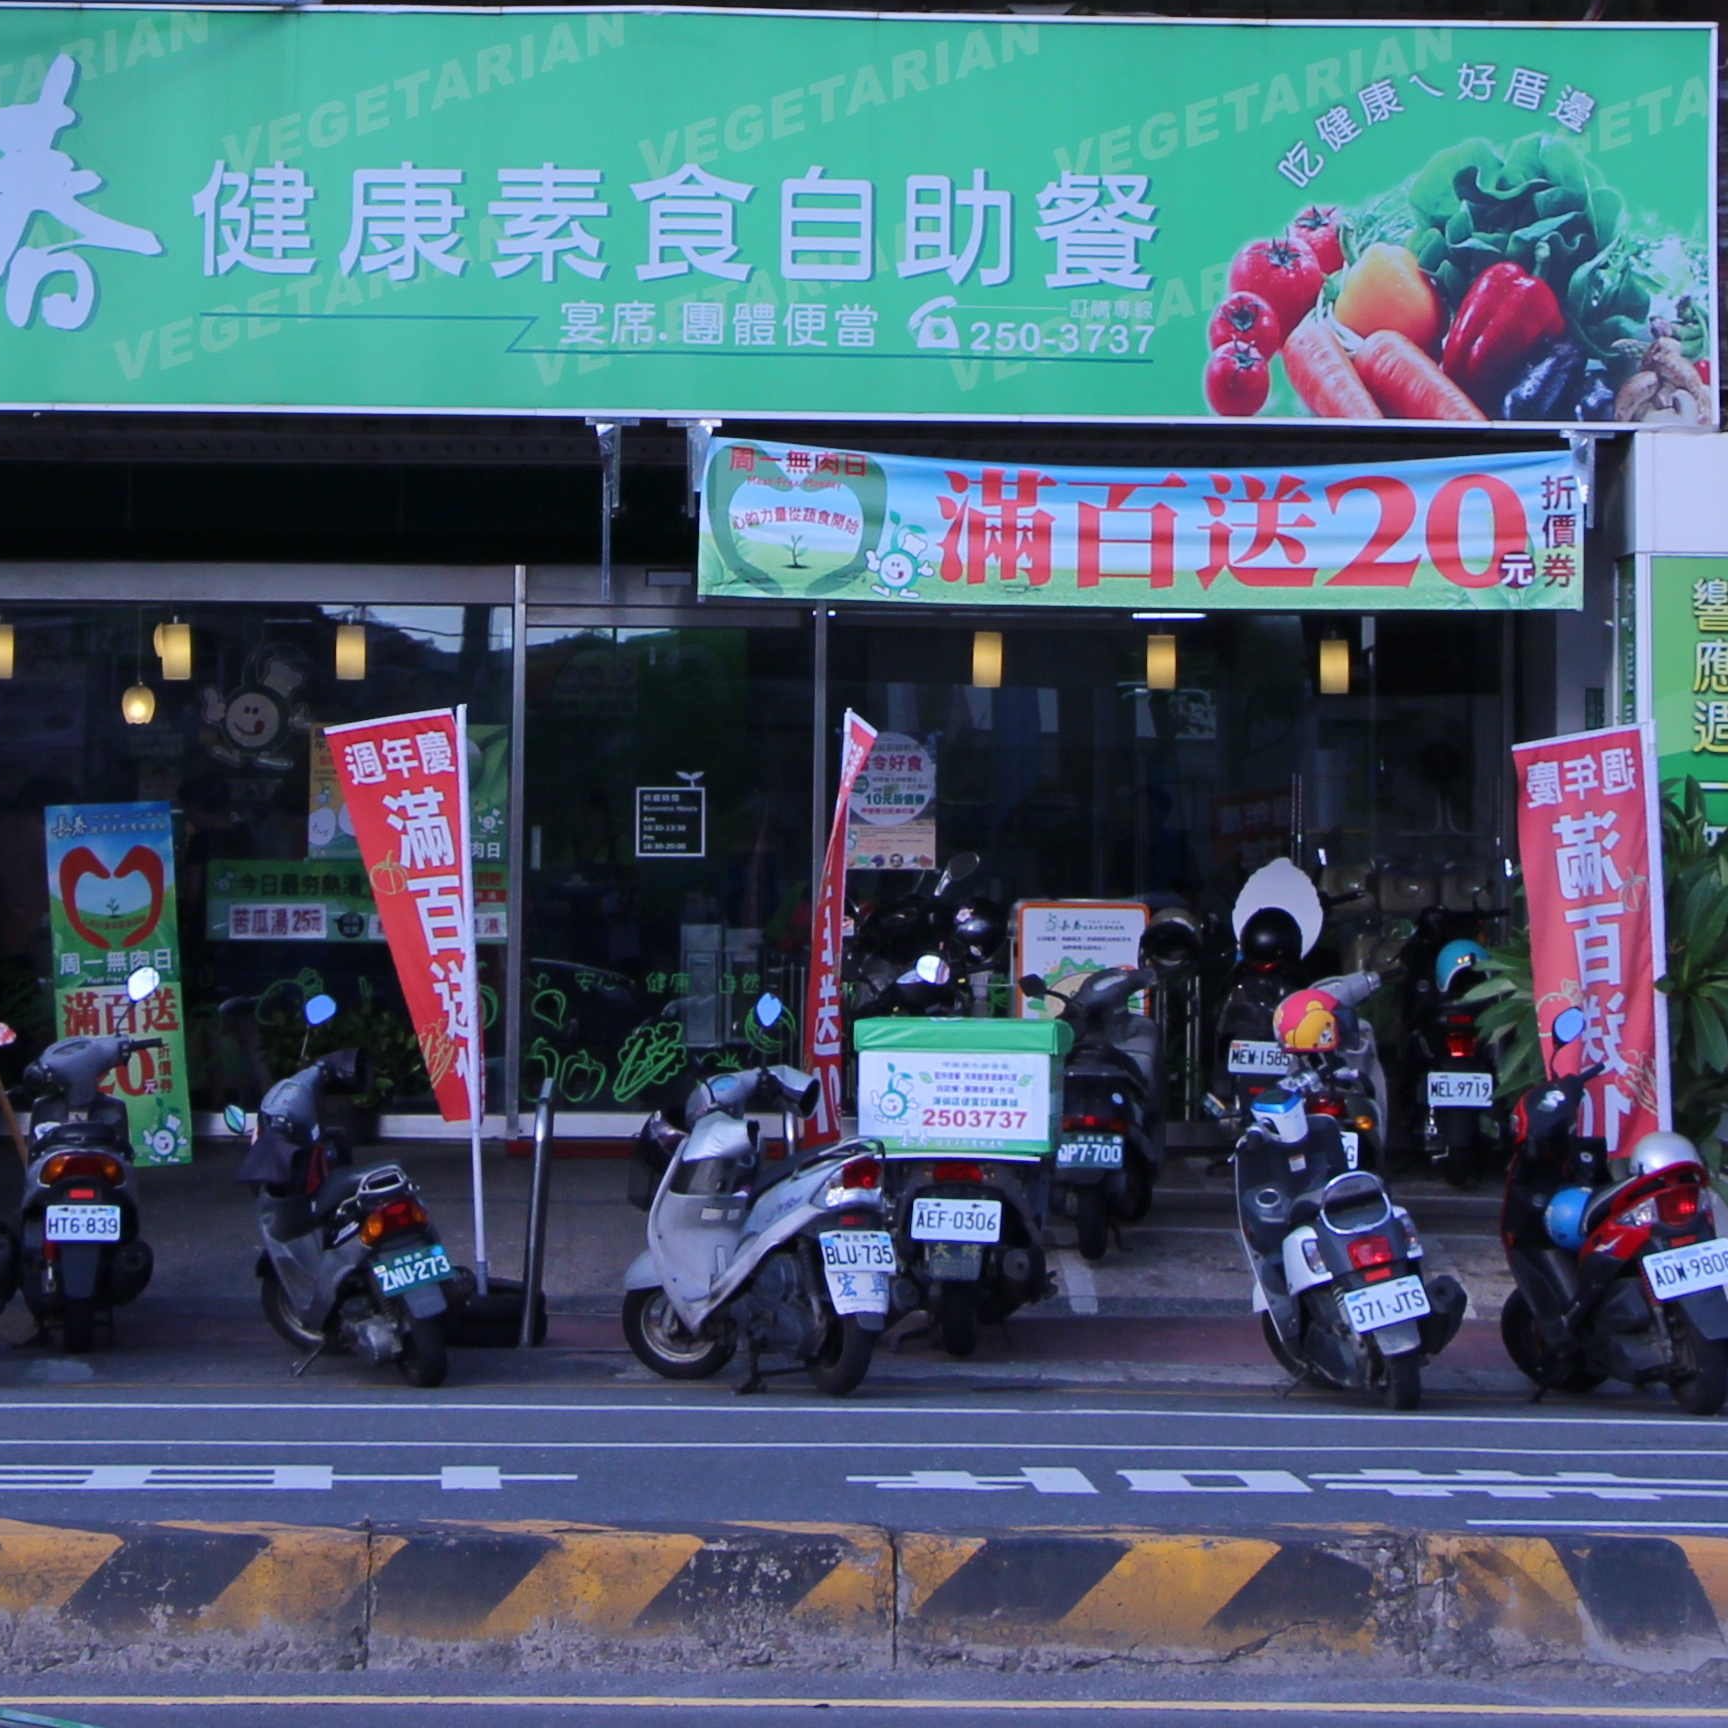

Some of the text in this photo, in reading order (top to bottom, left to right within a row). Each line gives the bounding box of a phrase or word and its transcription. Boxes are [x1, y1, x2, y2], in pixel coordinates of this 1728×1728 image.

[1052, 27, 1455, 180] VEGETARIAN
[193, 159, 1161, 291] 健康素食自助餐
[970, 321, 1156, 356] 250-3737
[729, 446, 869, 477] 周一無肉日
[936, 467, 1507, 590] 滿百送20
[1540, 474, 1577, 587] 折價券
[343, 731, 456, 786] 週年慶
[233, 909, 288, 934] 苦瓜湯
[59, 947, 172, 975] 周一無肉日
[62, 993, 179, 1037] 滿百送
[1230, 1049, 1291, 1068] MEW-1585
[1430, 1081, 1491, 1098] MEL-9719
[923, 1109, 1028, 1129] 2503737
[48, 1217, 118, 1234] HT6-839
[916, 1210, 997, 1232] AEF-0306
[825, 1244, 893, 1265] BLU-735
[377, 1254, 451, 1292] ZNU-273
[1351, 1288, 1426, 1325] 371-JTS
